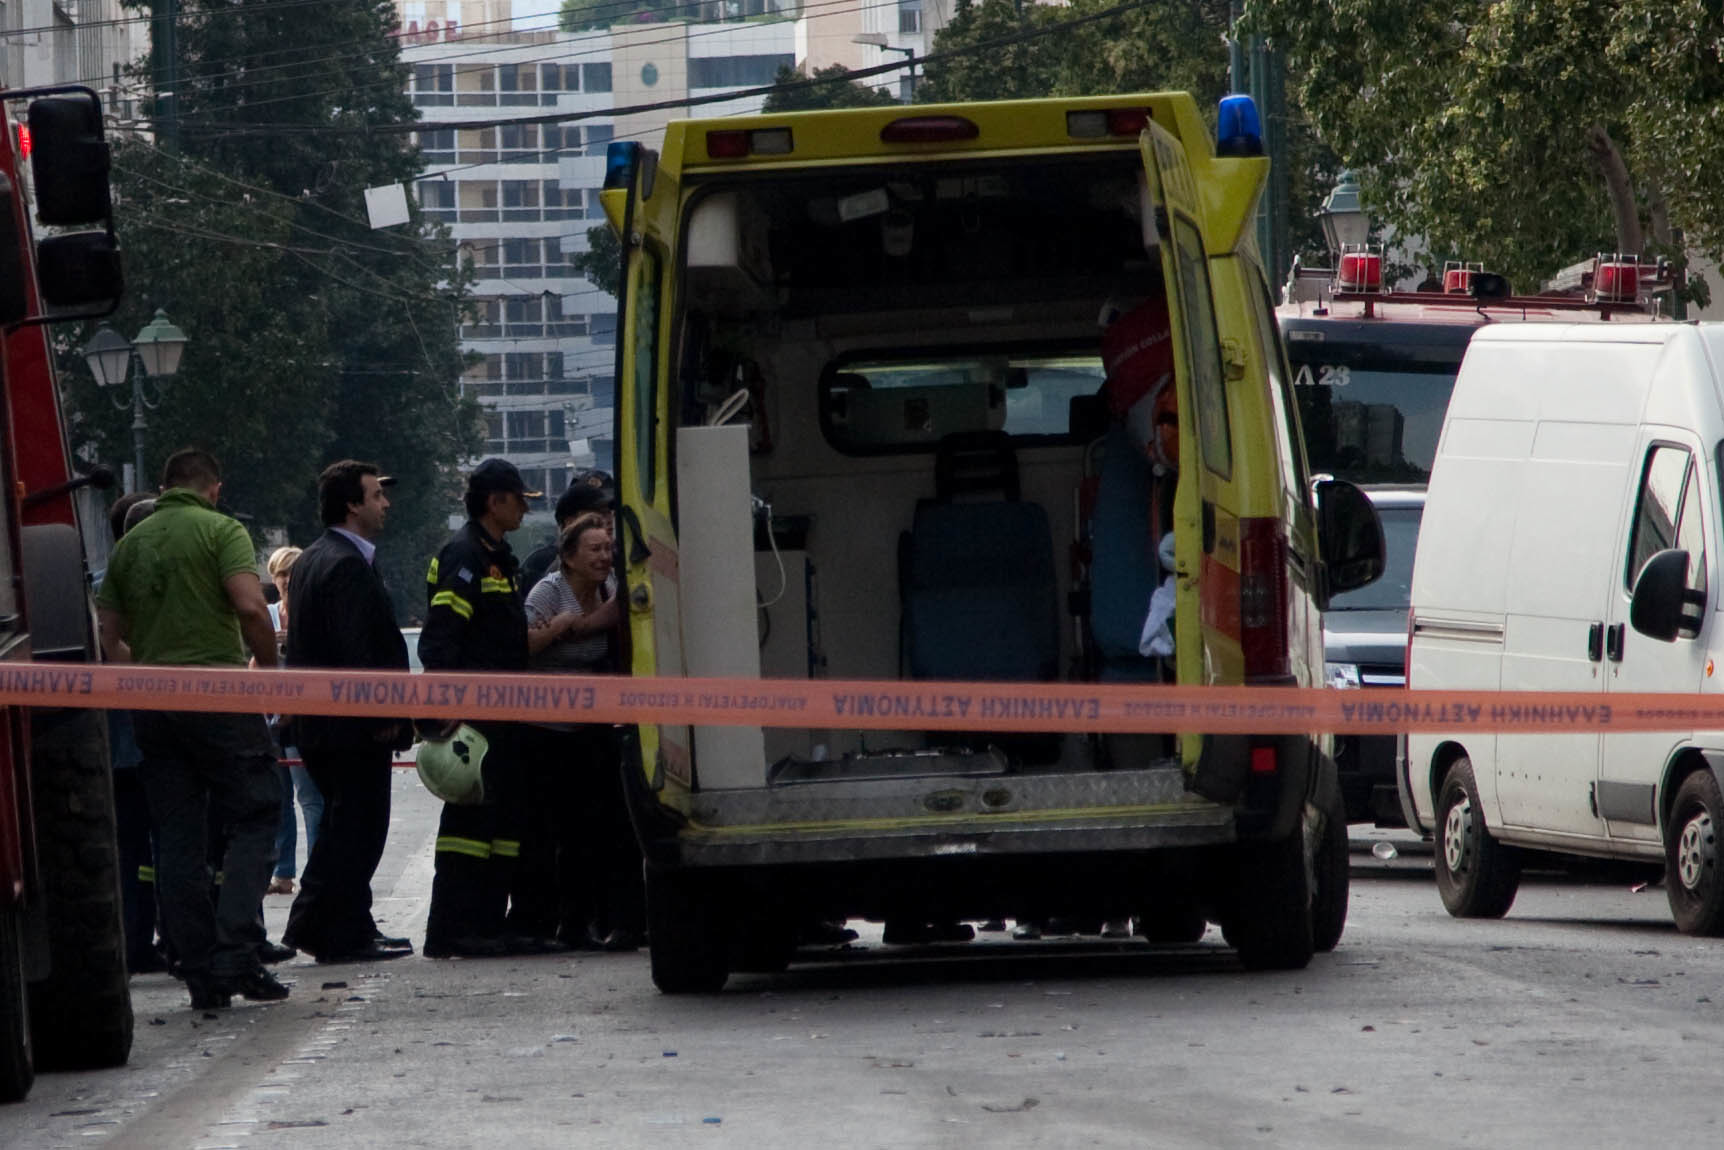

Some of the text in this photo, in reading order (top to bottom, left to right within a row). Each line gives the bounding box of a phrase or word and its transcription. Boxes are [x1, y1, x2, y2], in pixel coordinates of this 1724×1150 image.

[329, 679, 596, 709] ΕΛΛΗΝΙΚΗ ΑΣΤΥΝΟΜΙΑ
[833, 694, 1100, 719] ΕΛΛΗΝΙΚΗ ΑΣΤΥΝΟΜΙΑ
[1340, 702, 1482, 724] ΑΣΤΥΝΟΜΙΑ
[1491, 703, 1613, 724] ΕΛΛΗΝΙΚΗ
